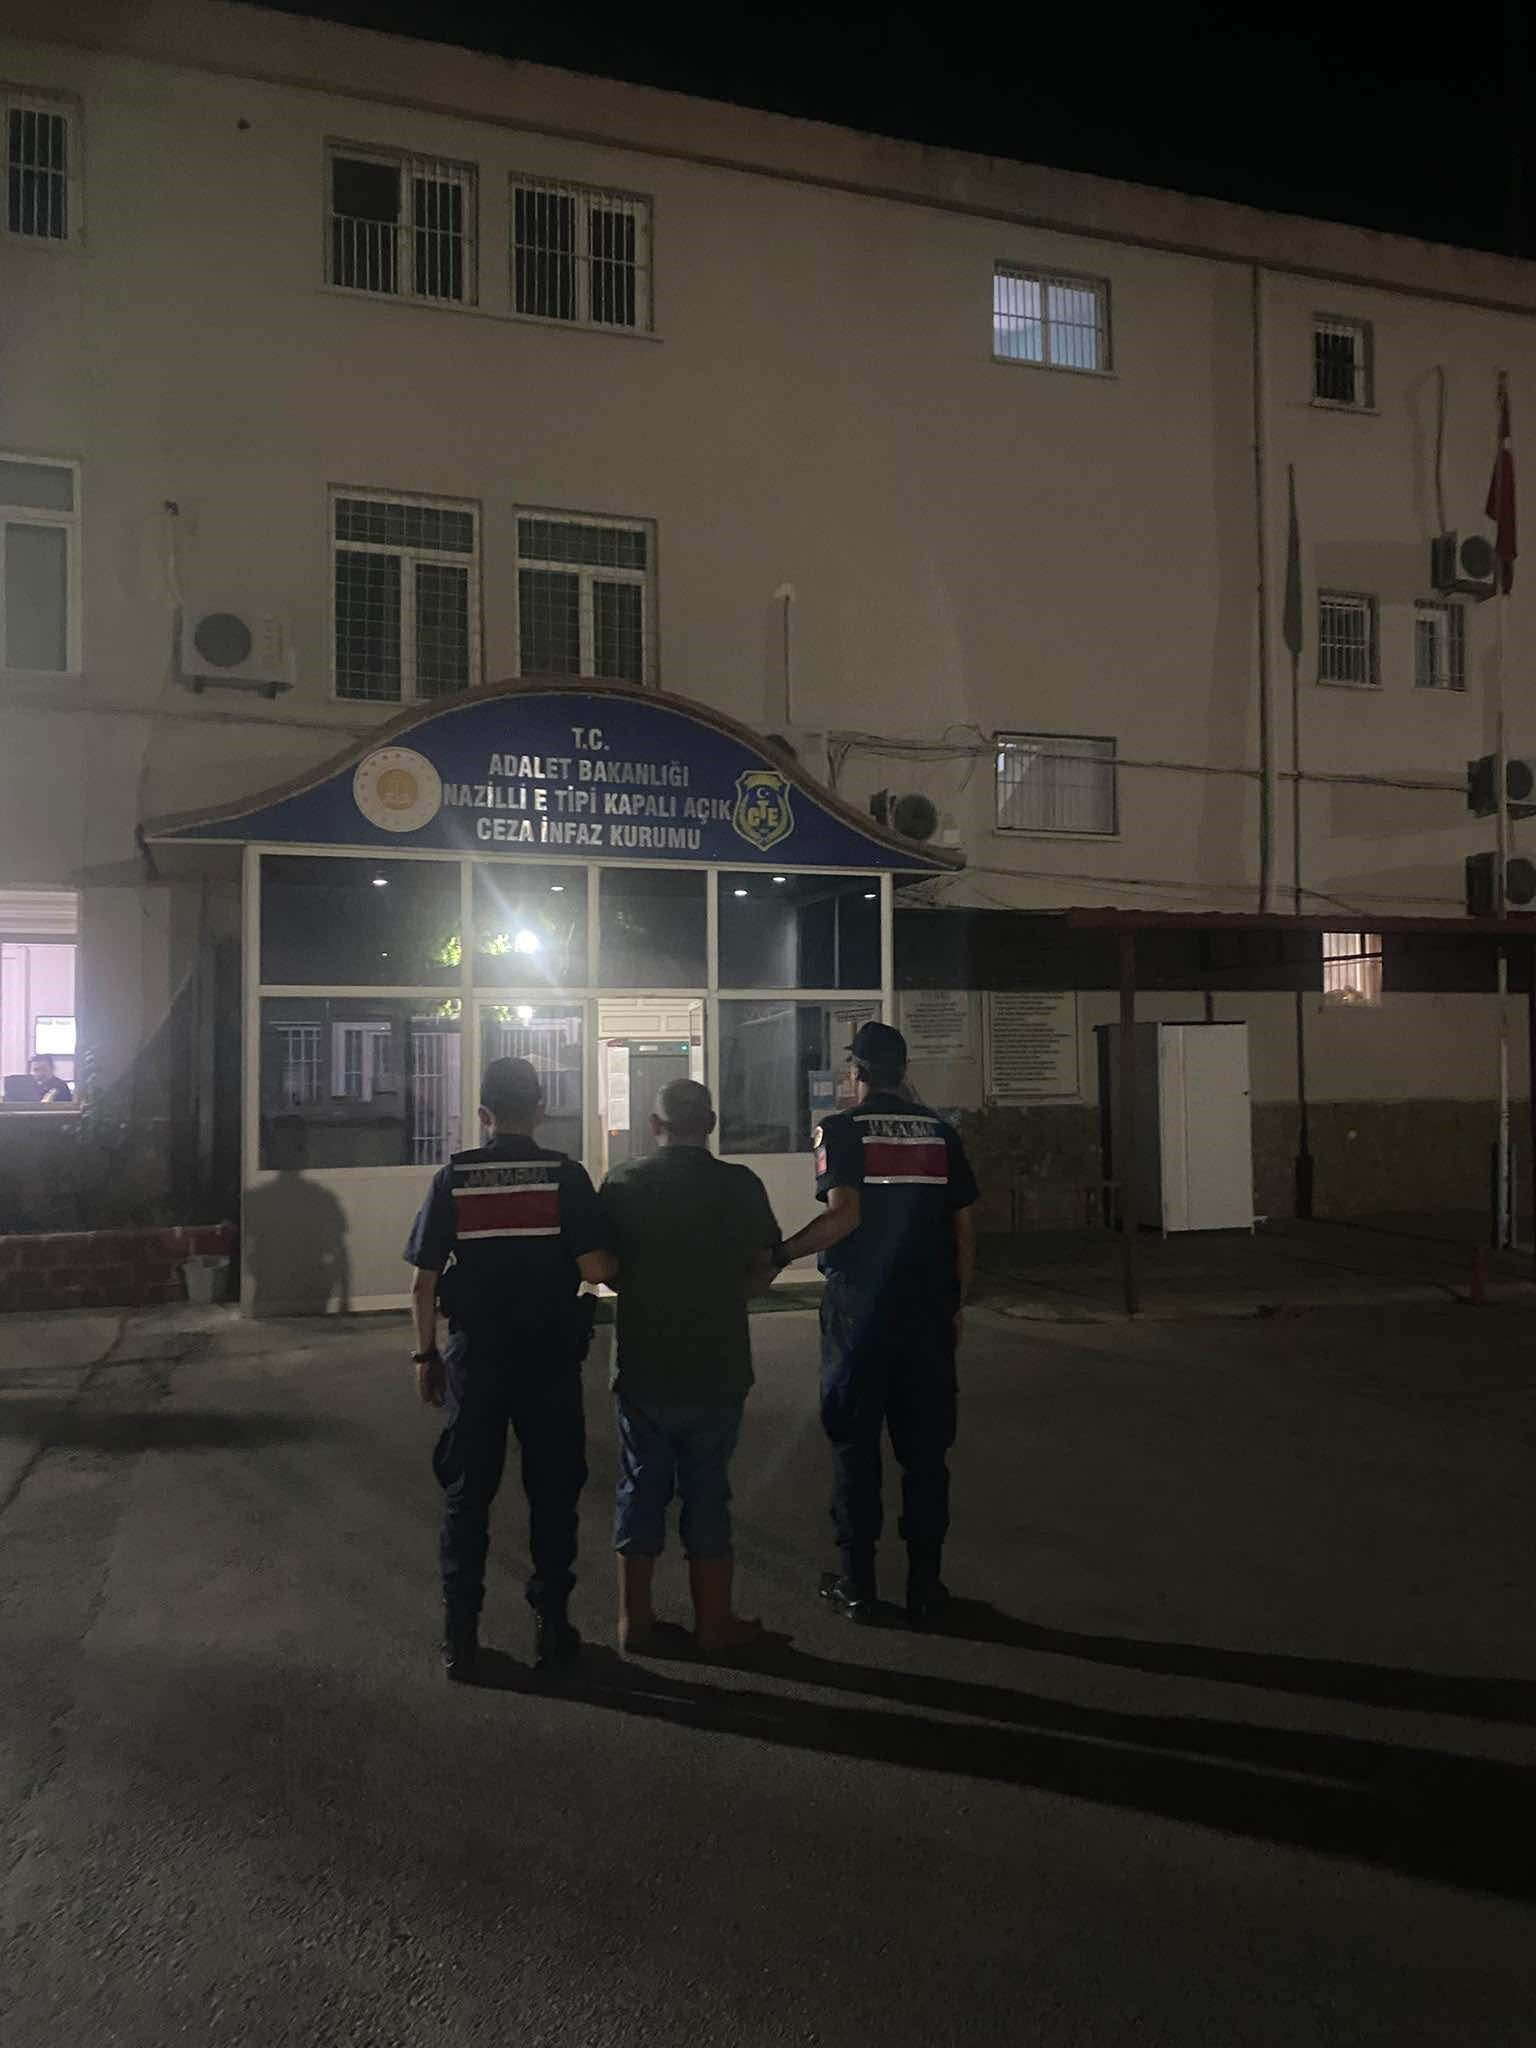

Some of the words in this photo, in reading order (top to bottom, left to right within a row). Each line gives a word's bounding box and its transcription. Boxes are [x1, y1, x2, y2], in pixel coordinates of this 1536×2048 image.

[571, 727, 610, 751] T.C.
[488, 753, 572, 780] ADALET
[579, 759, 689, 787] BAKANLIĞI
[442, 781, 527, 810] NAZİLLİ
[533, 788, 548, 812] E
[554, 785, 597, 814] TİPİ
[604, 793, 677, 817] KAPALI
[683, 796, 731, 824] AÇIK
[477, 817, 535, 843] CEZA
[540, 815, 604, 846] İNFAZ
[609, 823, 701, 850] KURUMU
